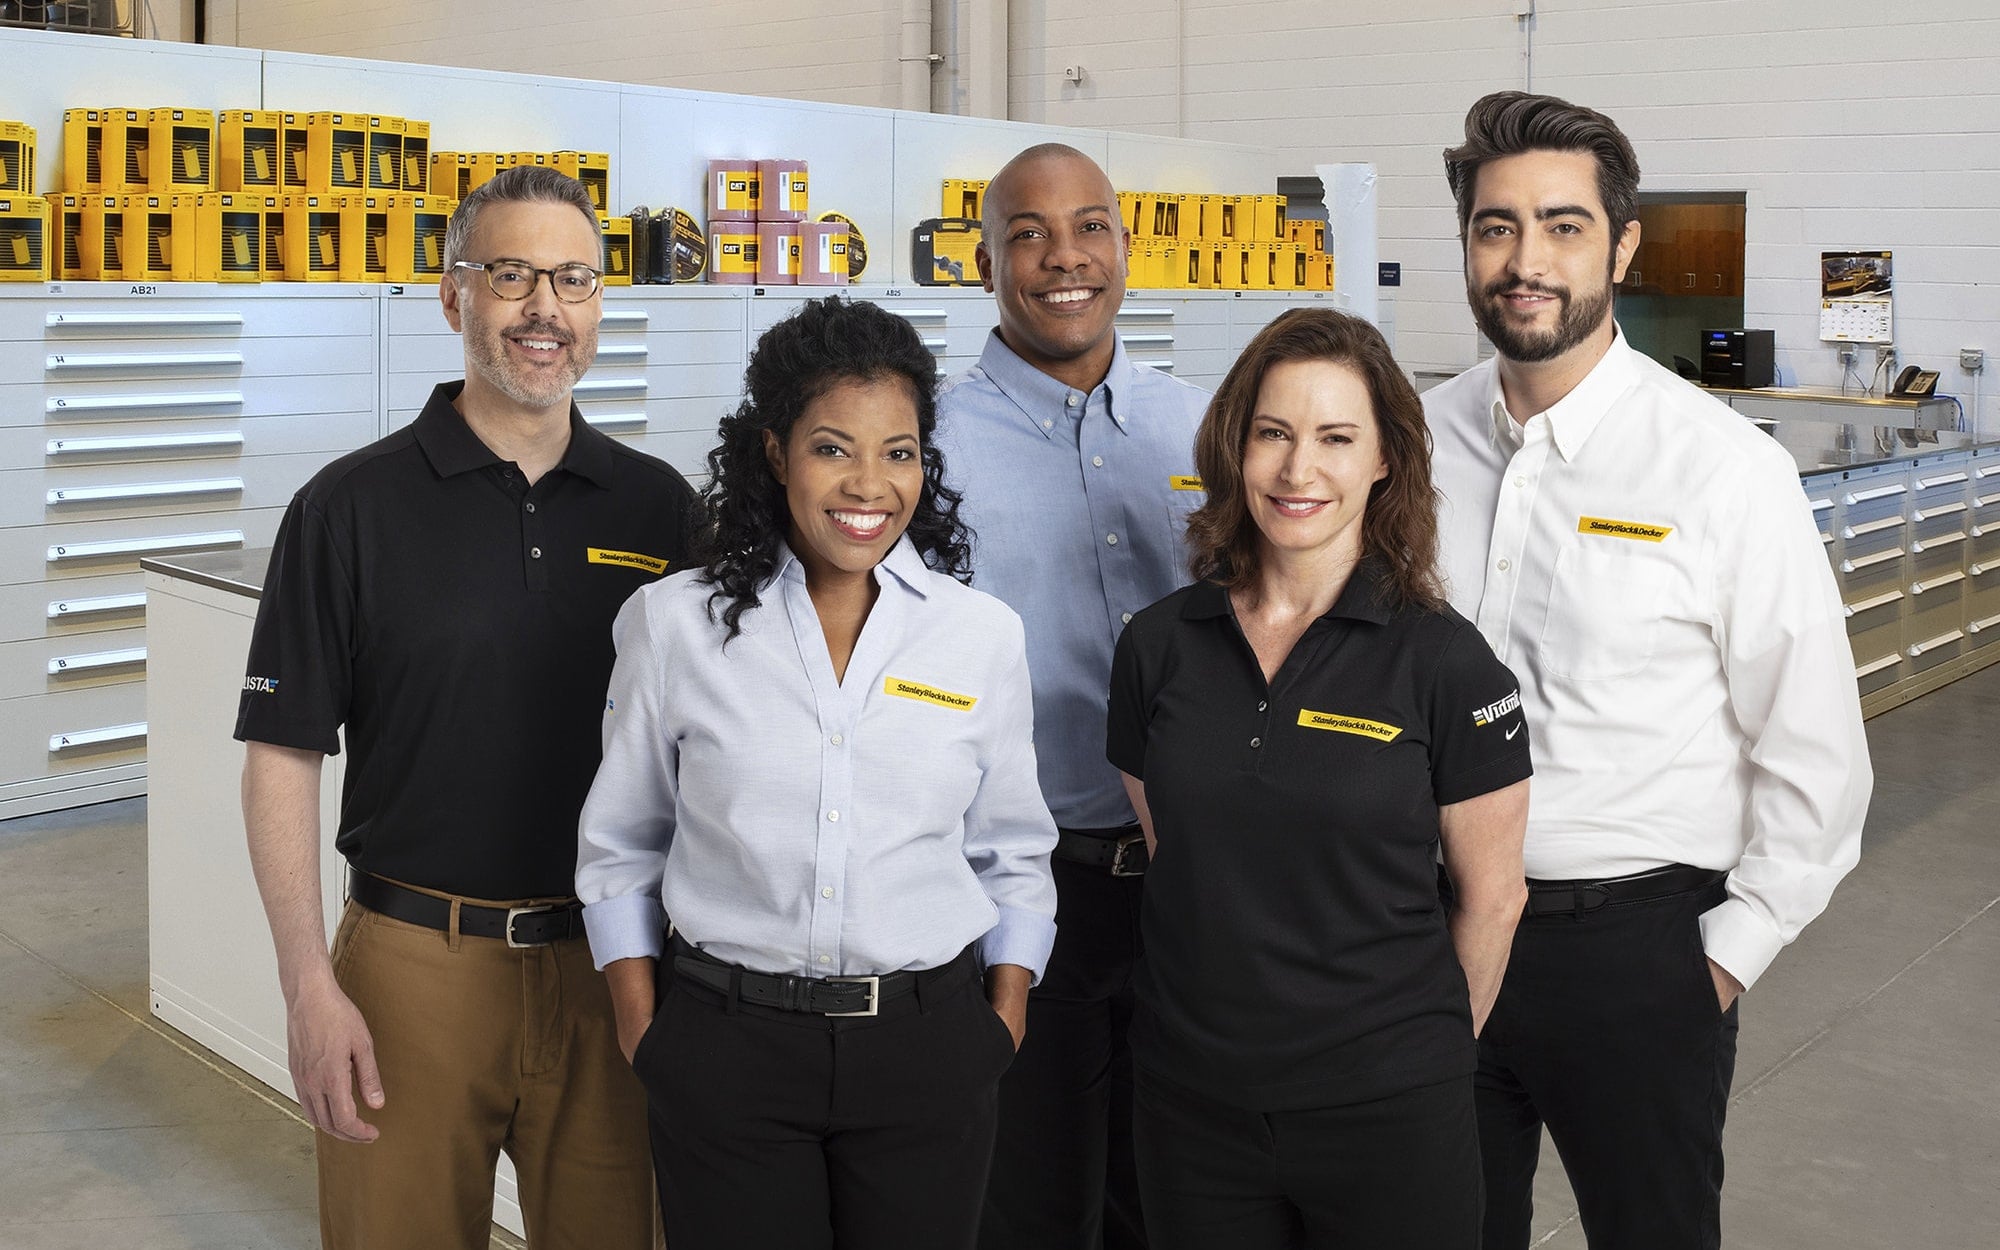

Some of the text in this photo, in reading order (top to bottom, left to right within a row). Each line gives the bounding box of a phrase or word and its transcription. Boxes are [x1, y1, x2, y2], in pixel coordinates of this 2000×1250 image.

[730, 182, 745, 191] CAT
[130, 286, 157, 295] AB21
[56, 355, 65, 363] H
[57, 399, 66, 407] G
[57, 491, 65, 499] E
[57, 546, 66, 555] D
[59, 603, 68, 612] C
[58, 659, 67, 668] B
[62, 736, 70, 745] A
